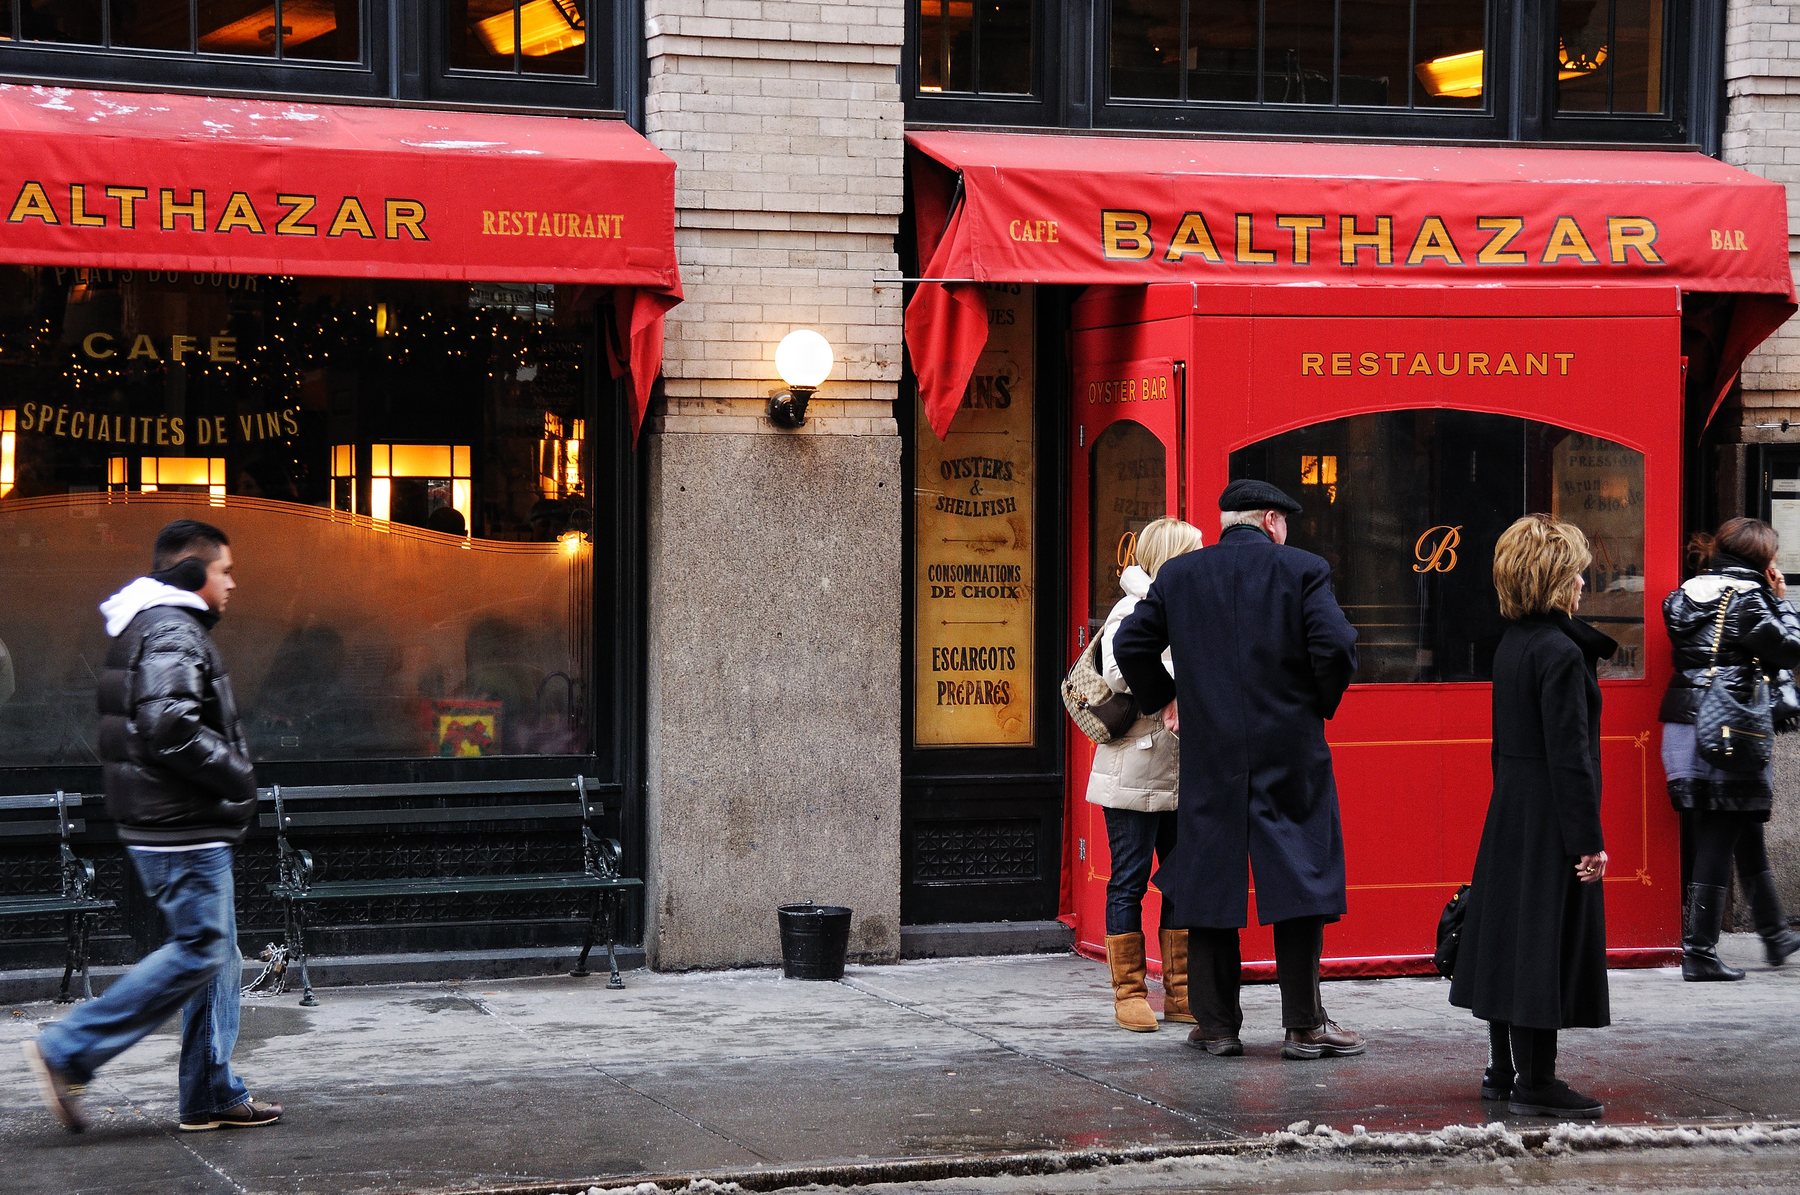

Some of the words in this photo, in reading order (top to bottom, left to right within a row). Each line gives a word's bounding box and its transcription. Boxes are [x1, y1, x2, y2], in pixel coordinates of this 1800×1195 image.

[6, 180, 430, 241] ALTHAZAR
[481, 210, 625, 239] RESTAURANT
[1009, 219, 1059, 244] CAFE
[1101, 208, 1666, 266] BALTHAZAR
[1710, 229, 1749, 252] BAR
[82, 329, 238, 363] CAFÉ
[1301, 351, 1575, 377] RESTAURANT
[962, 375, 1012, 409] INS
[1088, 378, 1137, 405] OYSTER
[1141, 375, 1168, 401] BAR
[21, 402, 185, 446] SPÉCIALITÉS
[198, 416, 228, 445] DE
[239, 409, 298, 441] VINS
[940, 455, 1015, 482] OYSTERS
[969, 480, 984, 496] &
[935, 495, 1018, 518] SHELLFISH
[928, 564, 1022, 584] CONSOMMATIONS
[930, 585, 957, 600] DE
[961, 585, 1020, 601] CHOIX
[932, 645, 1016, 673] ESCARGOTS
